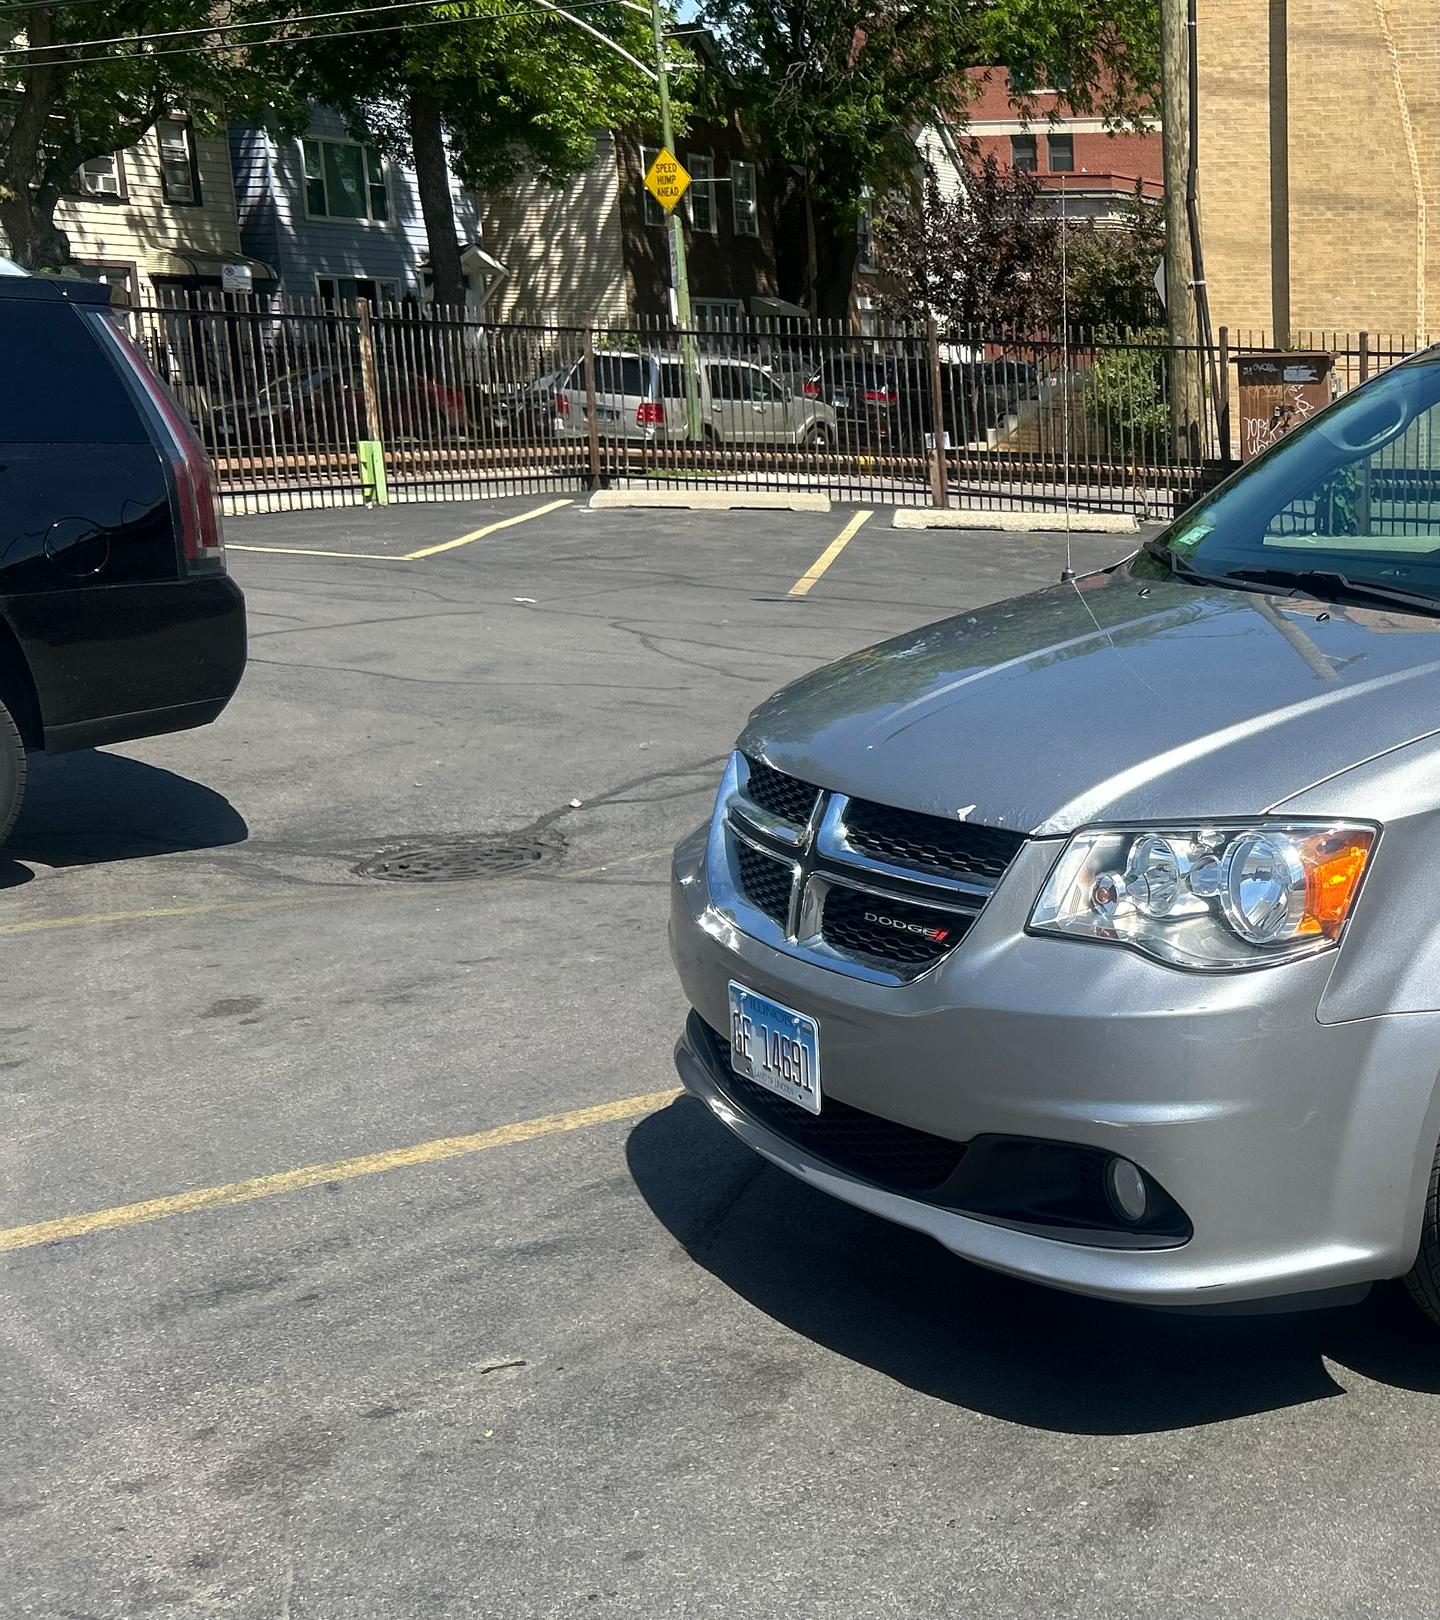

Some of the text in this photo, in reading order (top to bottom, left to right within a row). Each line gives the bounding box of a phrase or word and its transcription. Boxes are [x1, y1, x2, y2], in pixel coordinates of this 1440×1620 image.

[655, 163, 678, 174] SPEED
[657, 175, 677, 185] HUMP
[656, 186, 679, 197] AHEAD
[864, 912, 938, 937] DODGE
[750, 997, 793, 1025] ILLINOIS
[733, 1009, 814, 1094] GE 14691
